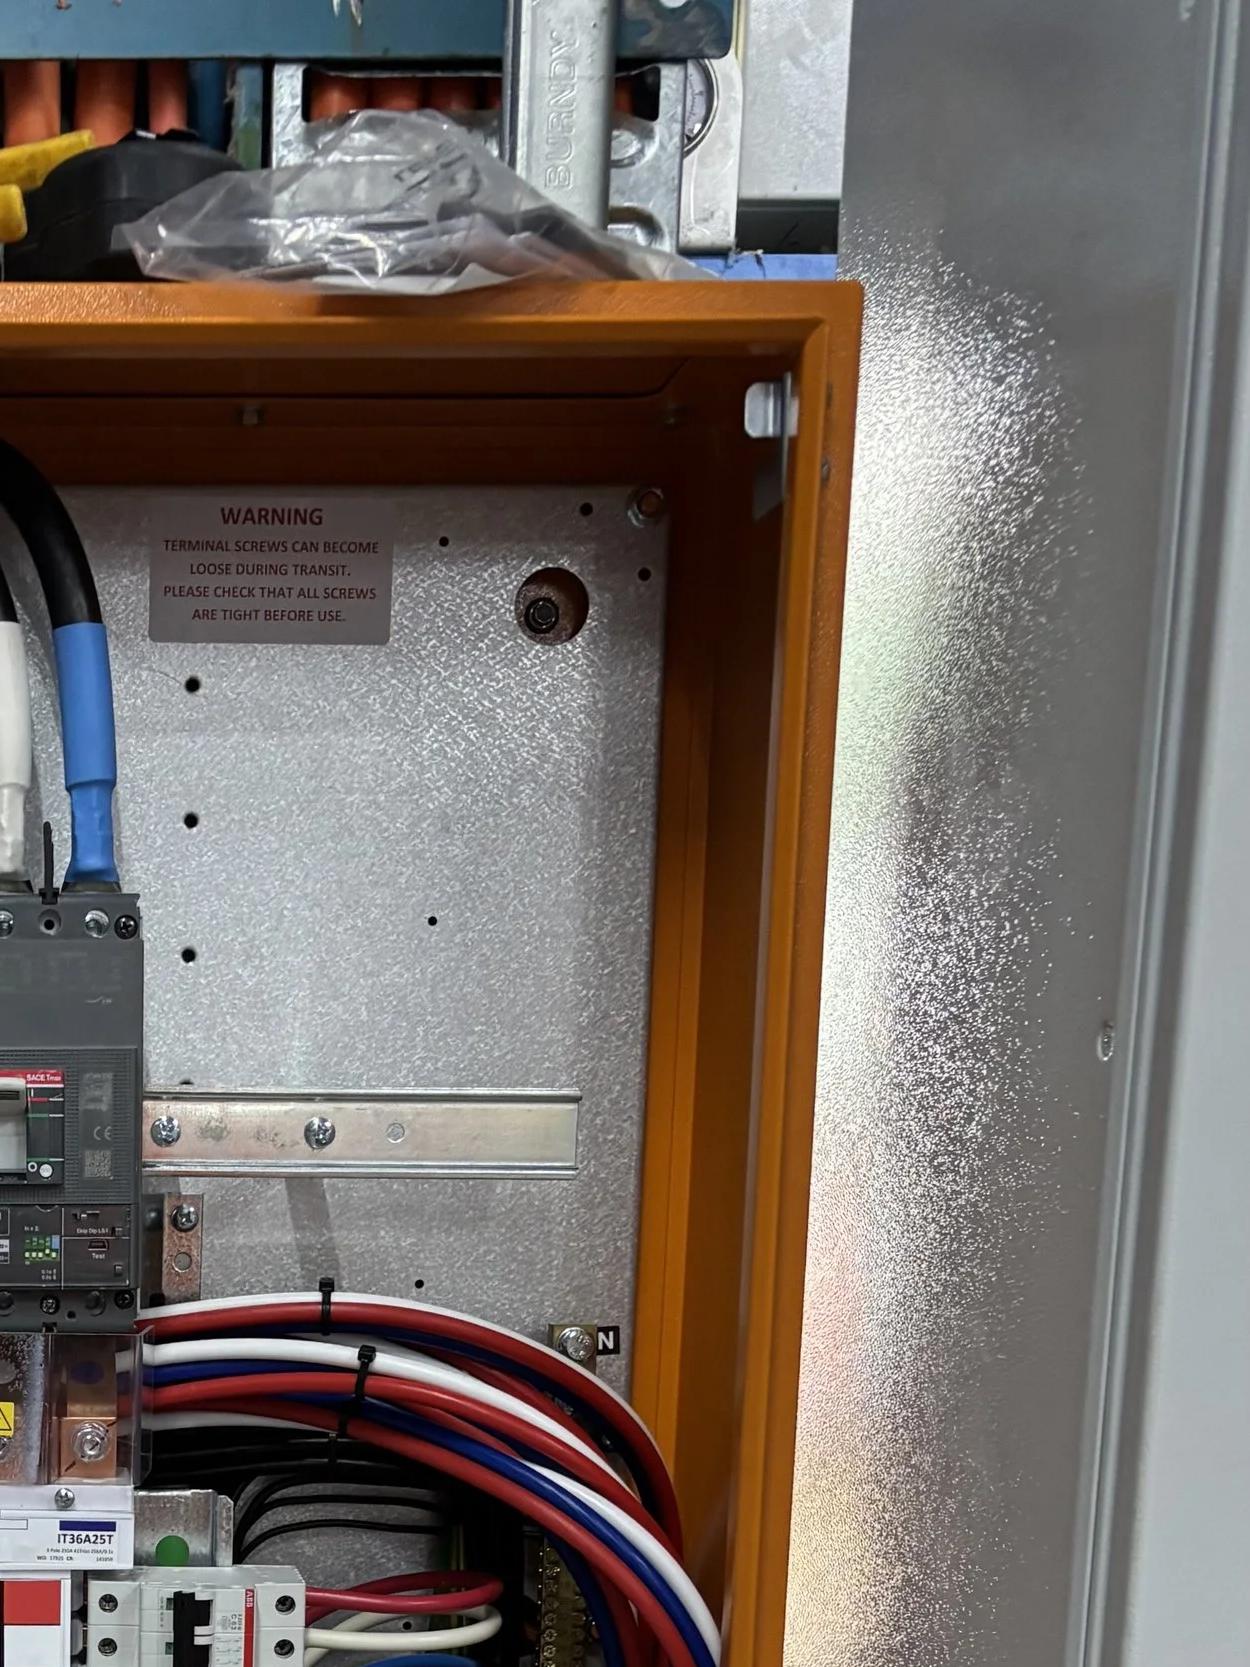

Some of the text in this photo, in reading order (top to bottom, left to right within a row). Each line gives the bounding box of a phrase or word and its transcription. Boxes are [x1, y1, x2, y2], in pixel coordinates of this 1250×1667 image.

[545, 31, 579, 189] BURNDY
[220, 507, 323, 526] WARNING
[163, 539, 379, 554] TERMINAL SCREWS CAN BECOME
[190, 563, 351, 576] LOOSE DURING TRANSIT.
[163, 586, 376, 600] PLEASE CHECK THAT ALL SCREWS
[192, 608, 346, 622] ARE TIGHT BEFORE USE.
[597, 1331, 614, 1350] N
[57, 1533, 114, 1545] IT36A25T
[245, 1591, 253, 1608] ABB
